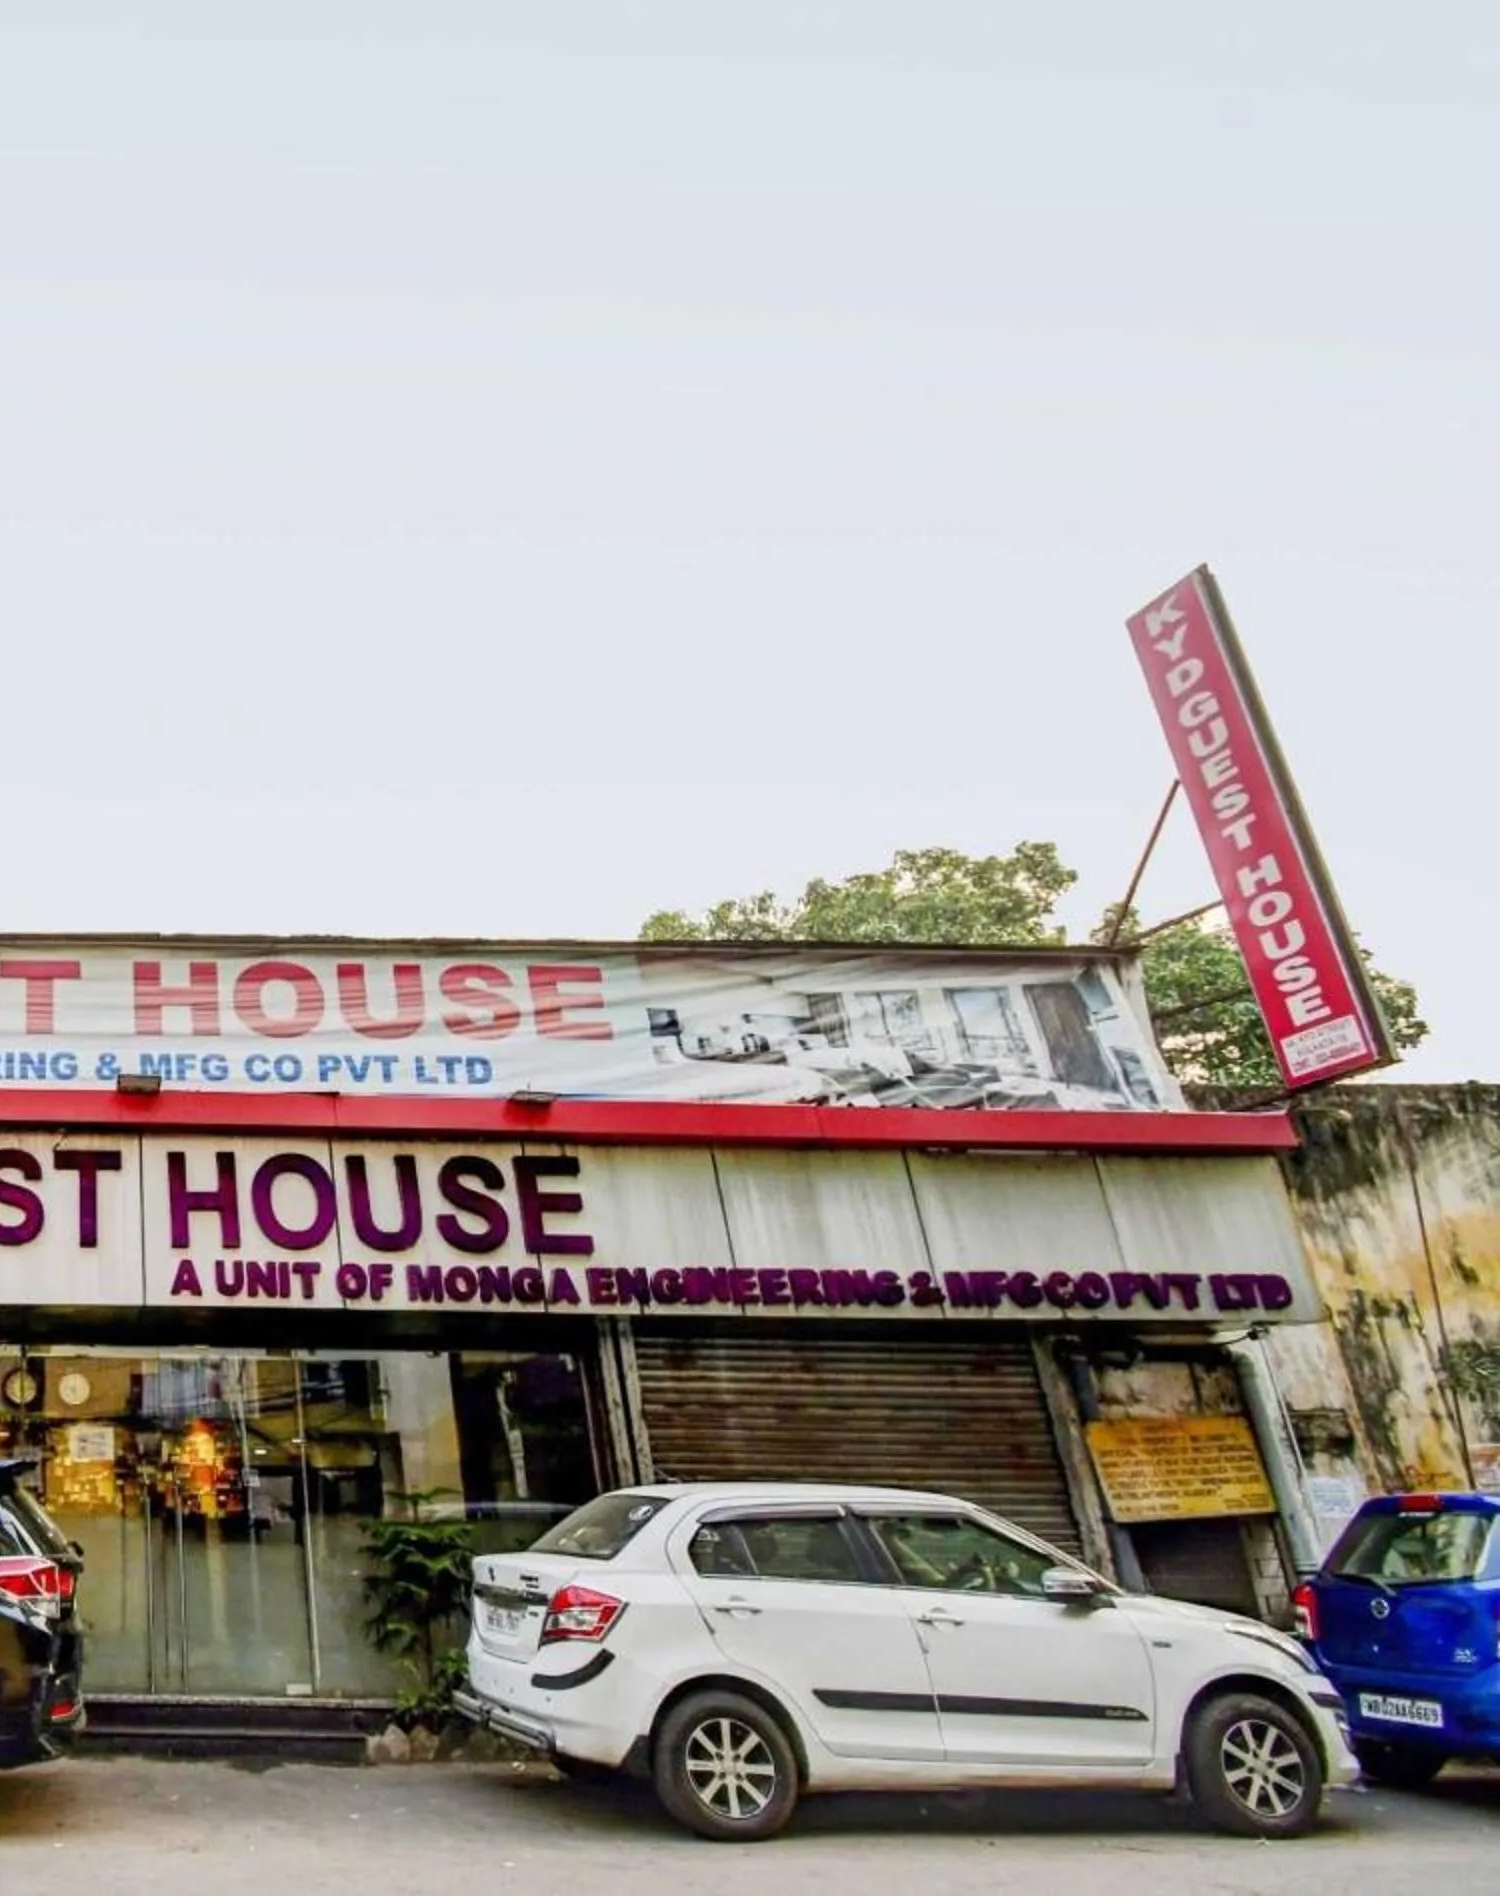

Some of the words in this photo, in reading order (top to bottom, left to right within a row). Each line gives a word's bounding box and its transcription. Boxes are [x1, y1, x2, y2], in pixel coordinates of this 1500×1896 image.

[1237, 853, 1332, 1027] HOUSE
[133, 961, 614, 1041] HOUSE
[95, 1053, 122, 1081] &
[139, 1053, 229, 1082] MFG
[244, 1054, 301, 1083] CO
[318, 1055, 399, 1084] PVT
[415, 1056, 494, 1085] LTD
[167, 1151, 595, 1256] HOUSE
[171, 1259, 202, 1296] A
[215, 1260, 320, 1299] UNIT
[337, 1263, 393, 1301] OF
[407, 1265, 581, 1305] MONGA
[586, 1267, 906, 1307] ENGINEERING
[908, 1270, 945, 1307] &
[1109, 1273, 1202, 1311] PVT
[1208, 1273, 1293, 1311] LTD
